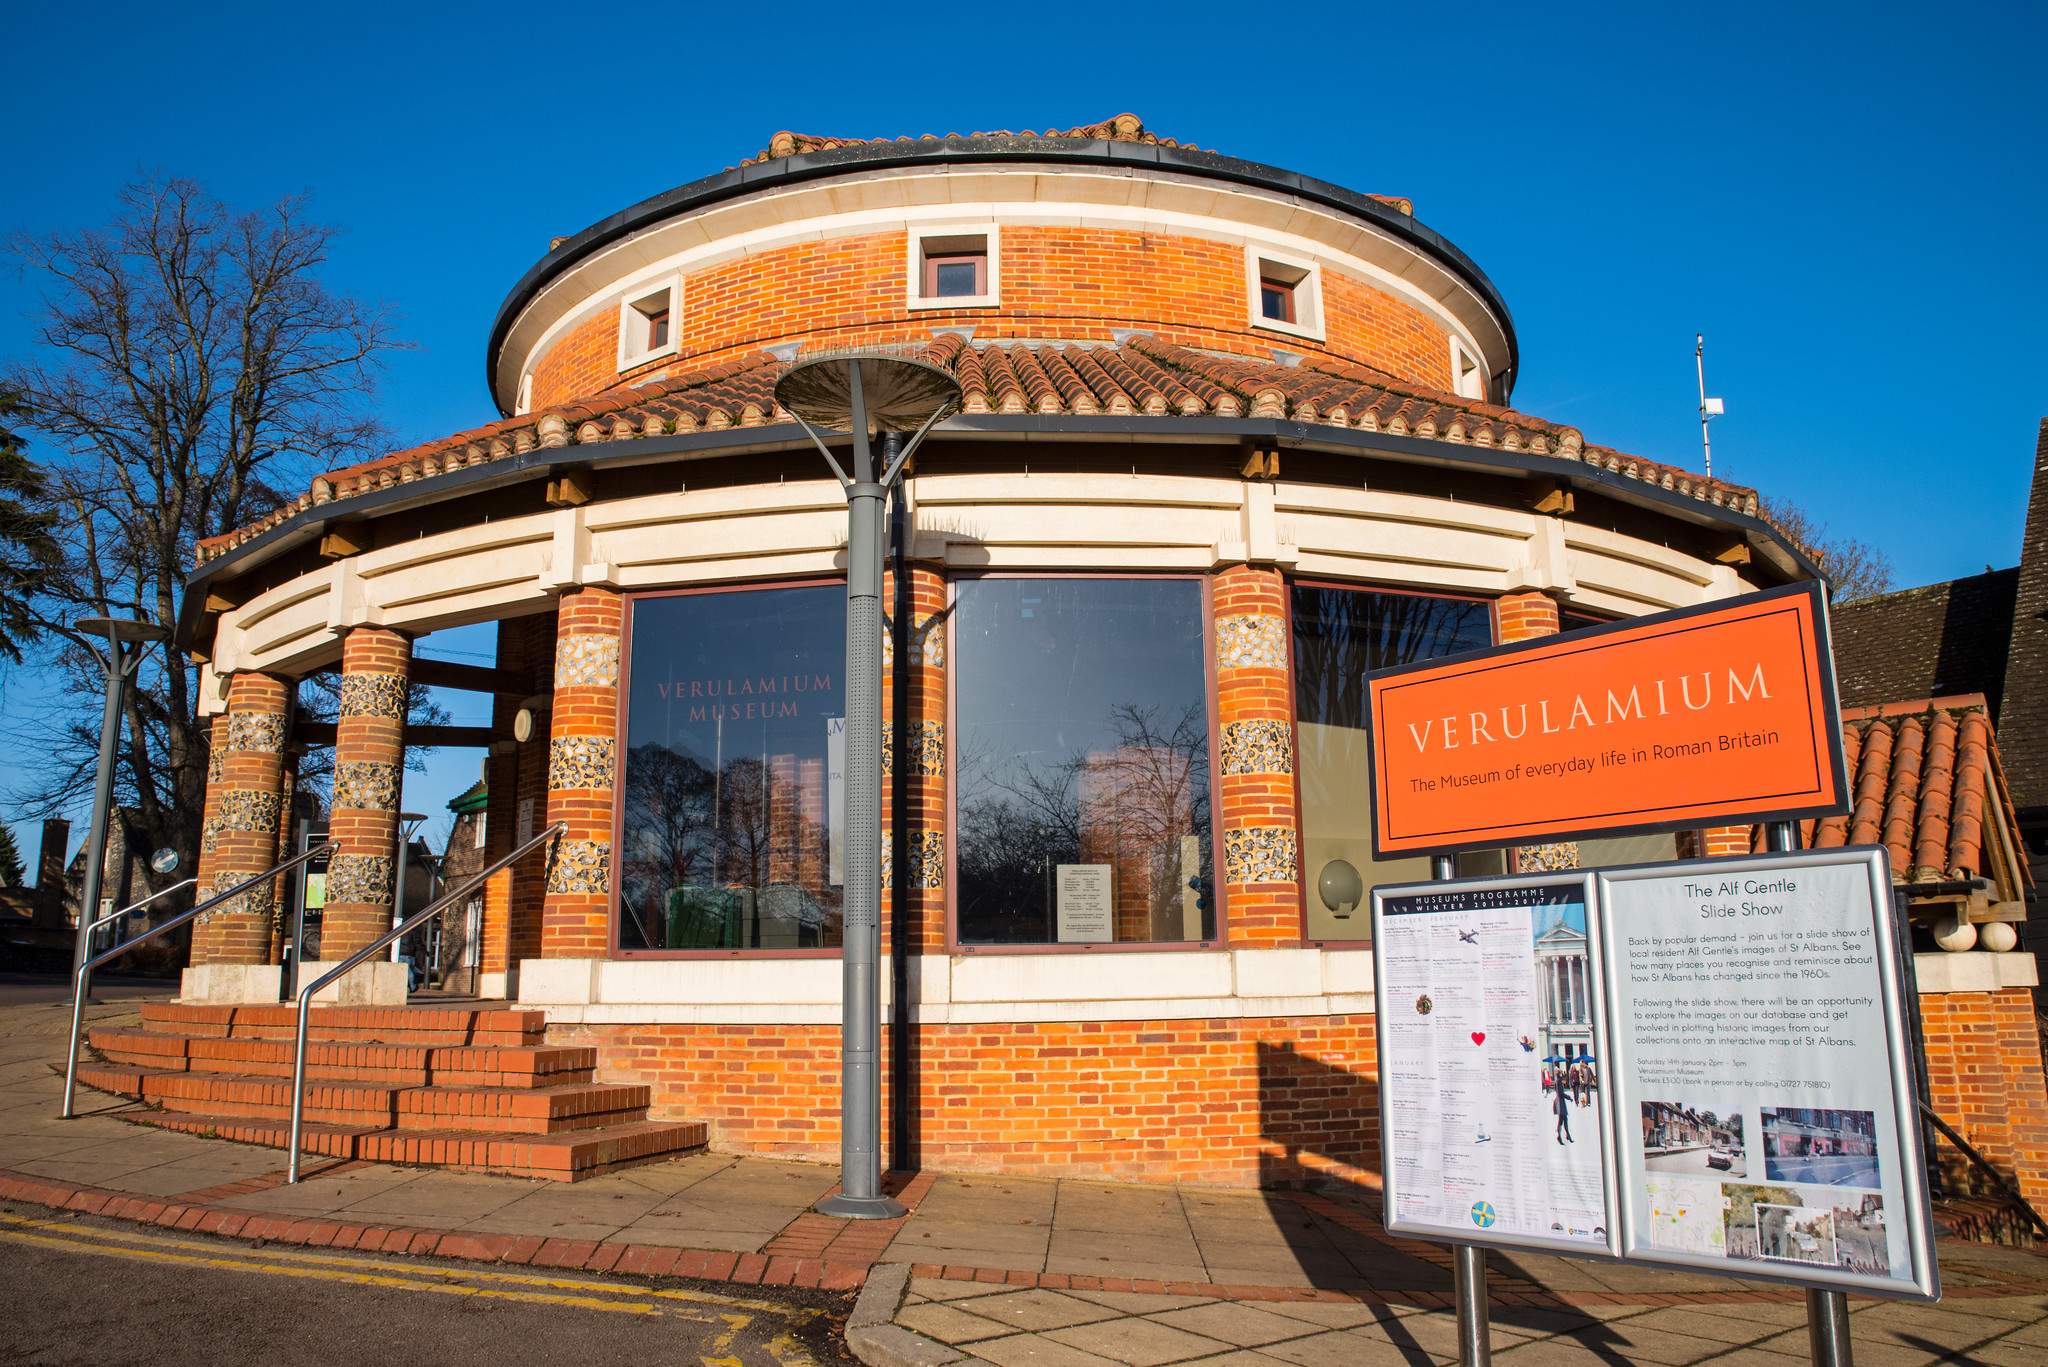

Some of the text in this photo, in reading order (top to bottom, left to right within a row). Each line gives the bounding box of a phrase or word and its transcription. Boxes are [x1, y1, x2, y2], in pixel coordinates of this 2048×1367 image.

[658, 673, 832, 699] VERULAMIUM
[689, 700, 798, 723] MUSEUM
[1407, 662, 1773, 753] VERULAMIUM
[1410, 729, 1779, 794] The Museum of everyday life in Roman Britain
[1416, 888, 1544, 904] MUSEUMS PROGRAMME
[1684, 878, 1796, 898] The Alf Gentle
[1416, 897, 1544, 911] WINTER 2016-2017
[1701, 901, 1783, 919] Slide Show
[1629, 937, 1649, 946] Back
[1652, 936, 1662, 946] by
[1665, 935, 1696, 945] popular
[1700, 933, 1737, 943] demand
[1748, 932, 1764, 943] join
[1767, 932, 1778, 940] us
[1781, 931, 1793, 940] for
[1806, 930, 1828, 939] slide
[1832, 928, 1857, 937] show
[1860, 927, 1870, 937] of
[1629, 941, 1861, 958] local resident Alf Gentle's images of St Albans. See
[1630, 955, 1872, 971] how many places you recognise and reminisce about
[1632, 969, 1831, 982] how St Albans has changed since the 1960s.
[1633, 998, 1672, 1009] Following
[1675, 997, 1688, 1007] the
[1692, 997, 1711, 1007] slide
[1742, 997, 1764, 1006] there
[1768, 996, 1783, 1006] will
[1786, 996, 1798, 1006] be
[1802, 998, 1813, 1006] an
[1817, 996, 1873, 1007] opportunity
[1645, 1011, 1675, 1021] explore
[1678, 1010, 1691, 1019] the
[1695, 1011, 1726, 1021] images
[1761, 1010, 1806, 1019] database
[1810, 1010, 1828, 1019] and
[1832, 1010, 1848, 1021] get
[1635, 1023, 1829, 1034] involved in plotting historic images from our
[1636, 1036, 1856, 1047] collections onto an interactive map of St Albans.
[1637, 1058, 1665, 1066] Saturday
[1709, 1058, 1723, 1066] 2pm
[1638, 1076, 1660, 1084] Tickets
[1683, 1077, 1701, 1085] (book
[1755, 1080, 1778, 1088] calling
[1781, 1080, 1800, 1088] 01727
